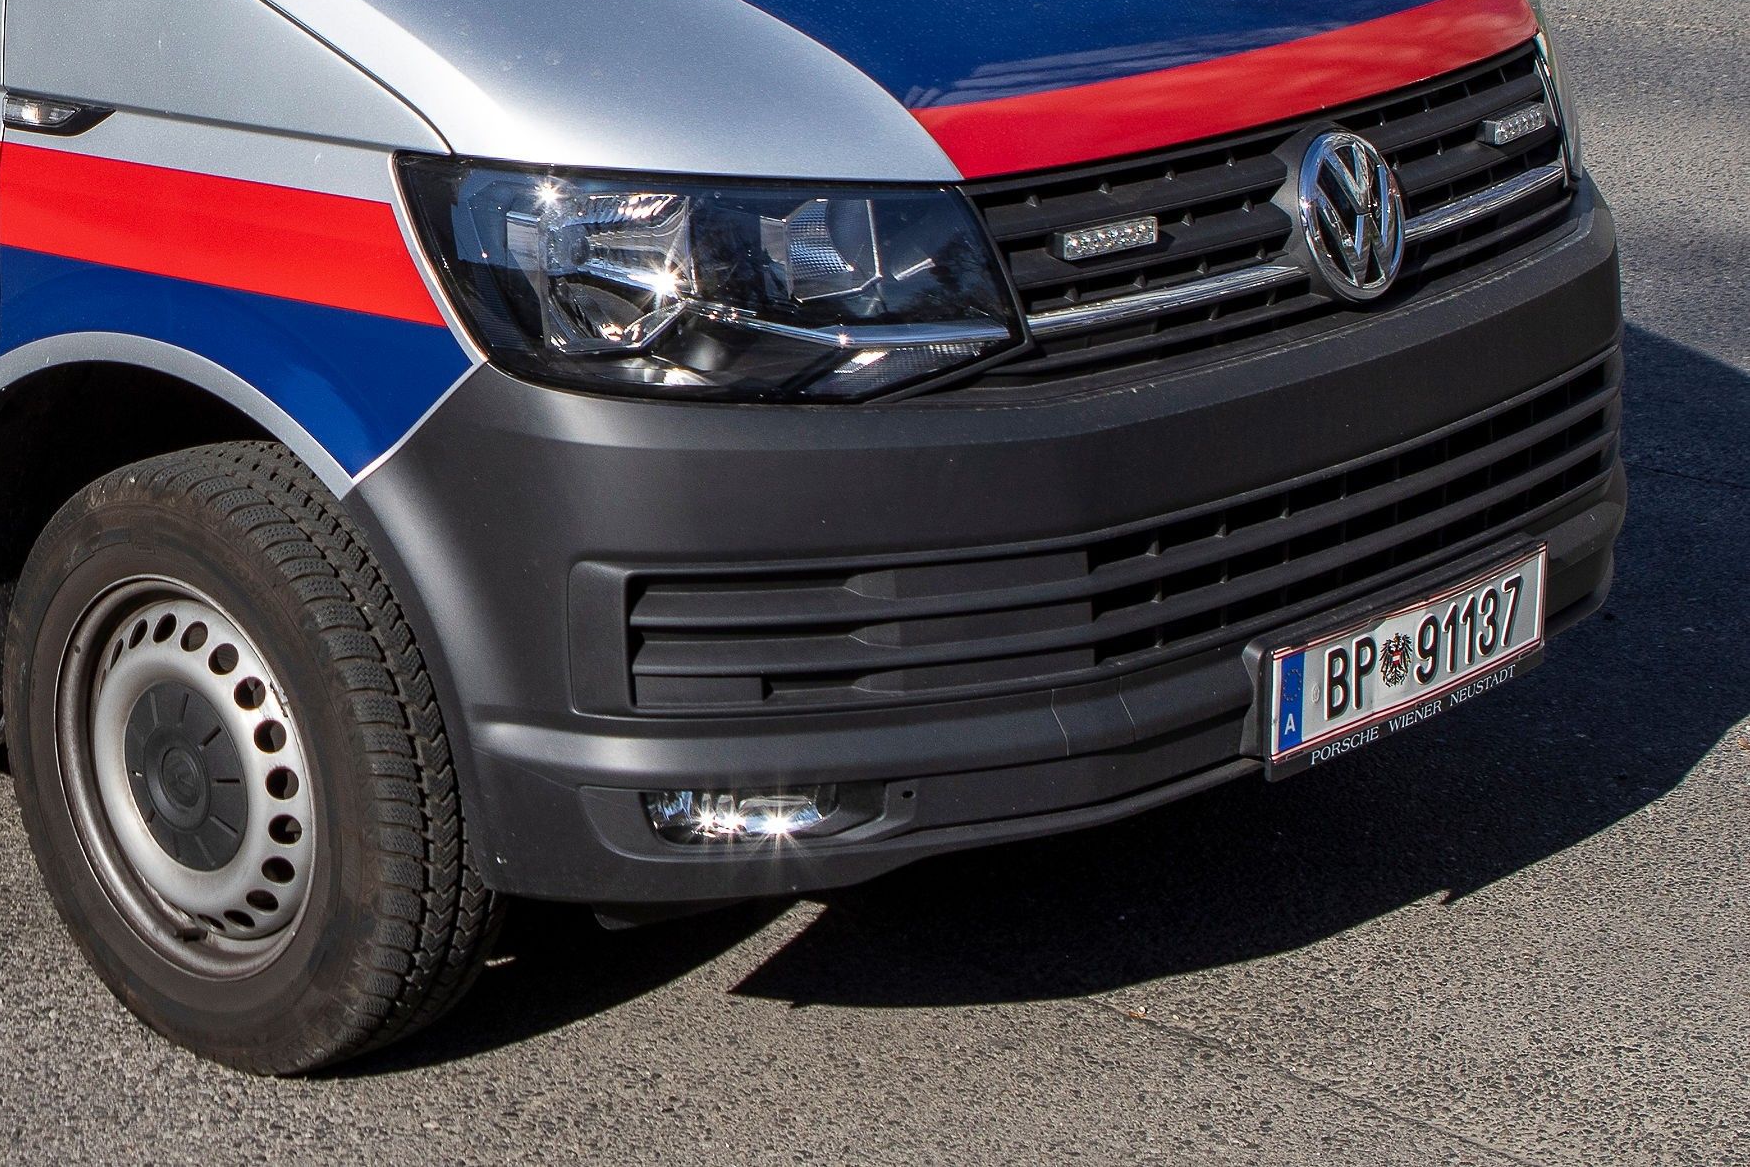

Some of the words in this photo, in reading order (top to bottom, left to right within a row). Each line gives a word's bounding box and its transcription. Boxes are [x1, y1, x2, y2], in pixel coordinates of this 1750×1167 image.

[1324, 636, 1377, 721] BP
[1414, 573, 1523, 685] 91137
[1284, 713, 1296, 735] A
[1311, 726, 1379, 765] PORSCHE
[1389, 702, 1442, 733] WIENER
[1450, 665, 1517, 707] NEUSTADT
